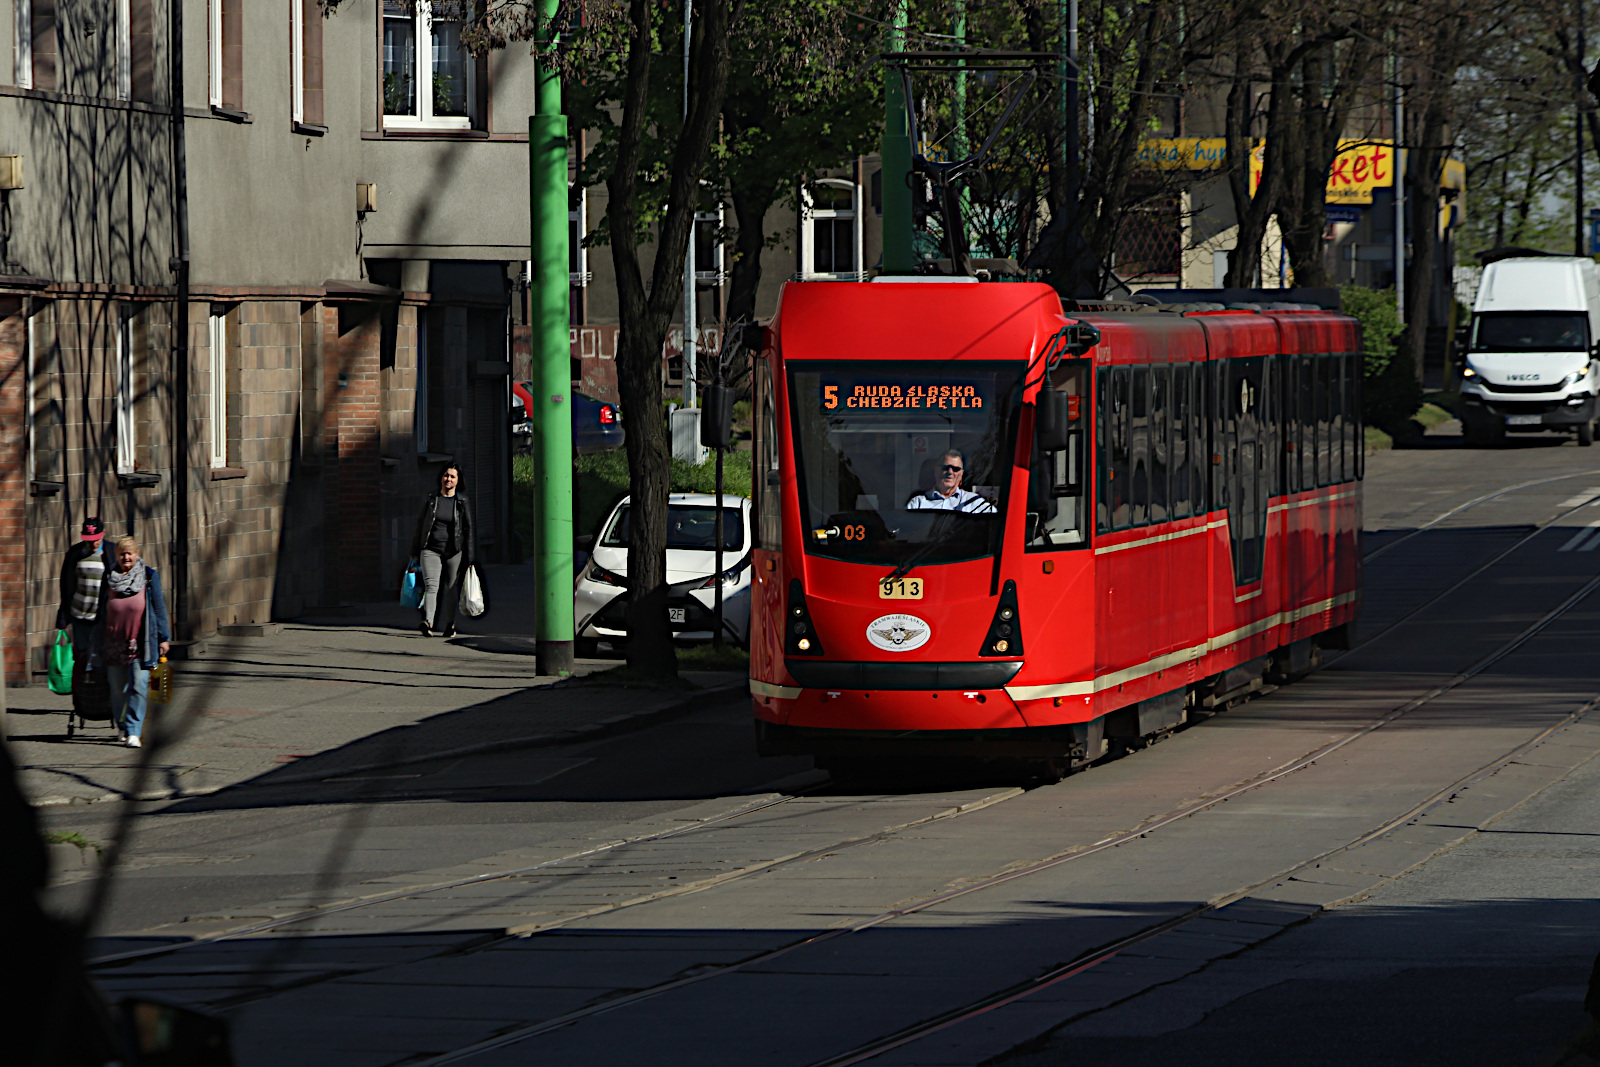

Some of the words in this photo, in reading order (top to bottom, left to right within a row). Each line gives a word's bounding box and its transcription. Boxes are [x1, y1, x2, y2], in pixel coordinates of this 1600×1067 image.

[1133, 146, 1179, 162] awa
[1193, 140, 1227, 162] hur
[1330, 145, 1387, 187] ket
[824, 385, 839, 409] 5
[854, 385, 901, 397] RUDA
[906, 385, 975, 398] ŚLĄSKA
[846, 396, 921, 408] CHEBZIE
[926, 396, 983, 409] PĘTLA
[844, 524, 866, 541] 03
[883, 581, 920, 596] 913
[670, 609, 684, 620] 2F
[870, 615, 901, 629] TRAMWAJE
